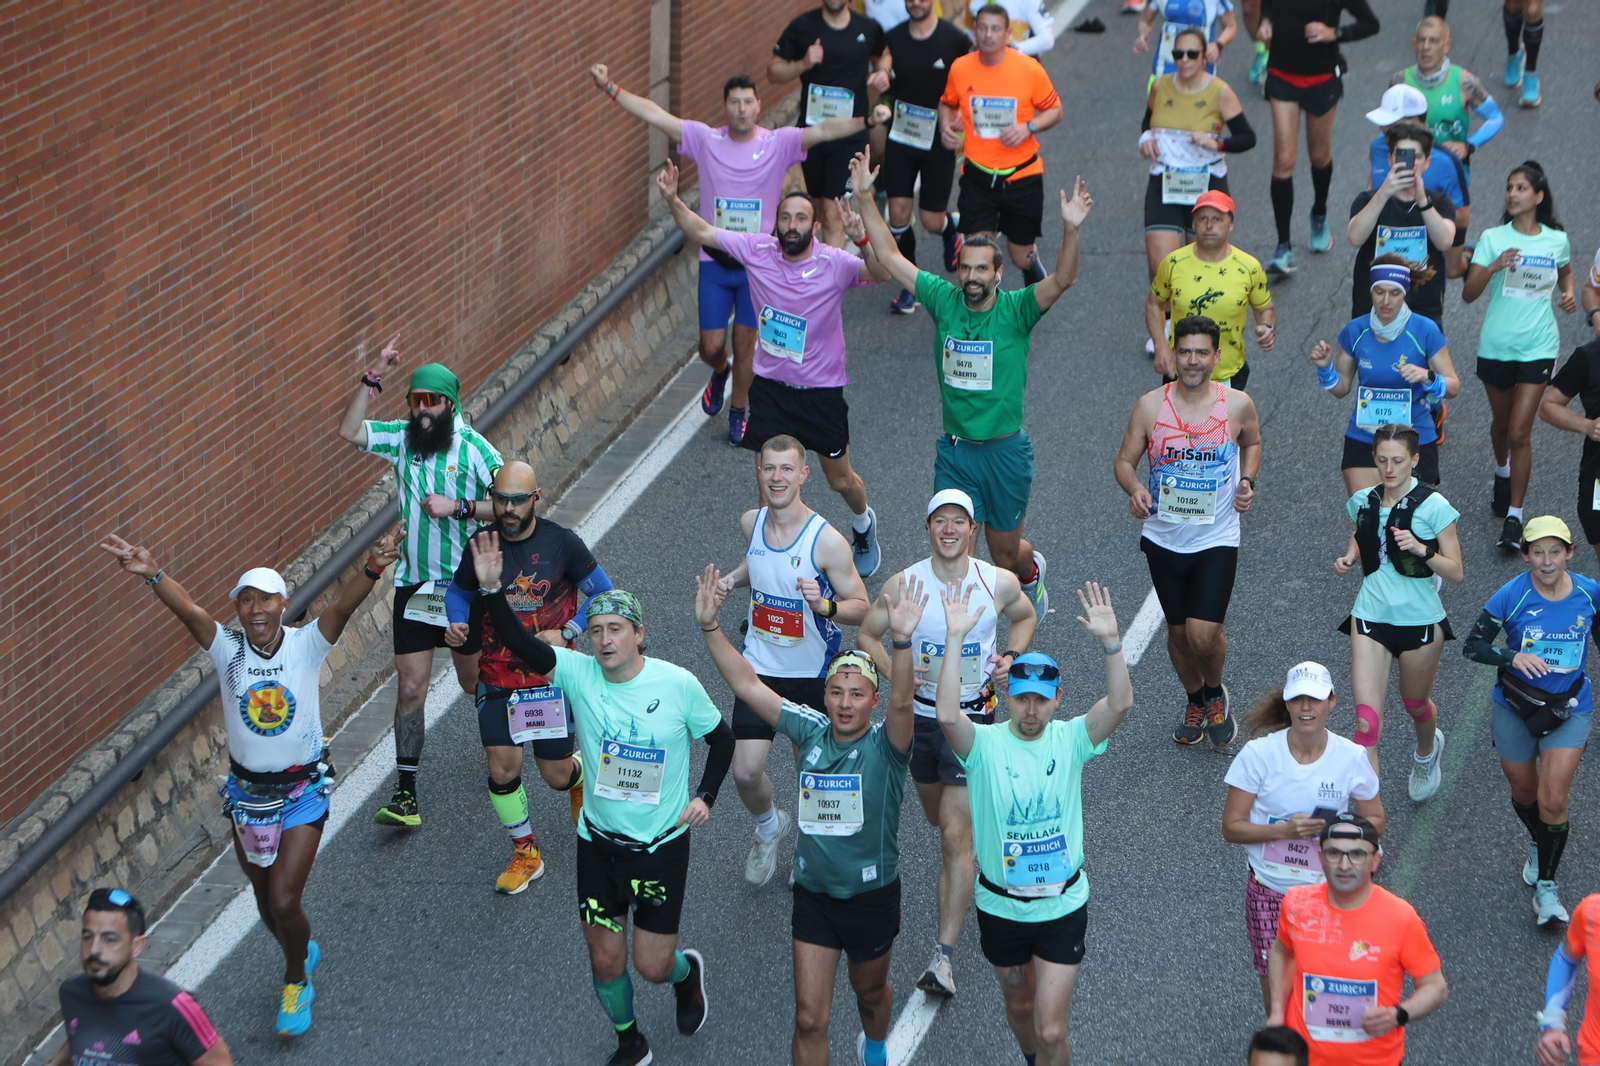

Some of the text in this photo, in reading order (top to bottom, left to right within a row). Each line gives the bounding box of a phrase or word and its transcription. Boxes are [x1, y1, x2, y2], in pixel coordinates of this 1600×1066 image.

[1526, 257, 1552, 266] ZURICH
[775, 315, 801, 328] ZURICH
[956, 343, 985, 352] ZURICH
[956, 360, 972, 368] 9478
[953, 369, 977, 378] ALBERTO
[1166, 446, 1216, 462] TriSani
[1180, 480, 1210, 490] ZURICH
[1176, 496, 1198, 505] 10182
[1168, 505, 1205, 515] FLORENTINA
[427, 604, 443, 613] SEVE
[767, 598, 796, 609] ZURICH
[767, 614, 784, 624] 1023
[1543, 647, 1562, 655] 6176
[1293, 672, 1318, 680] SPIRIT
[523, 691, 554, 700] ZURICH
[525, 709, 544, 718] 6938
[623, 749, 657, 760] ZURICH
[618, 767, 643, 778] 11132
[616, 780, 639, 789] JESUS
[818, 779, 851, 788] ZURICH
[818, 799, 840, 809] 10937
[1026, 841, 1060, 853] ZURICH
[1288, 842, 1309, 854] 8427
[1284, 856, 1309, 867] DAFNA
[1028, 862, 1049, 872] 6218
[1328, 982, 1366, 994] ZURICH
[1328, 1004, 1350, 1016] 7927
